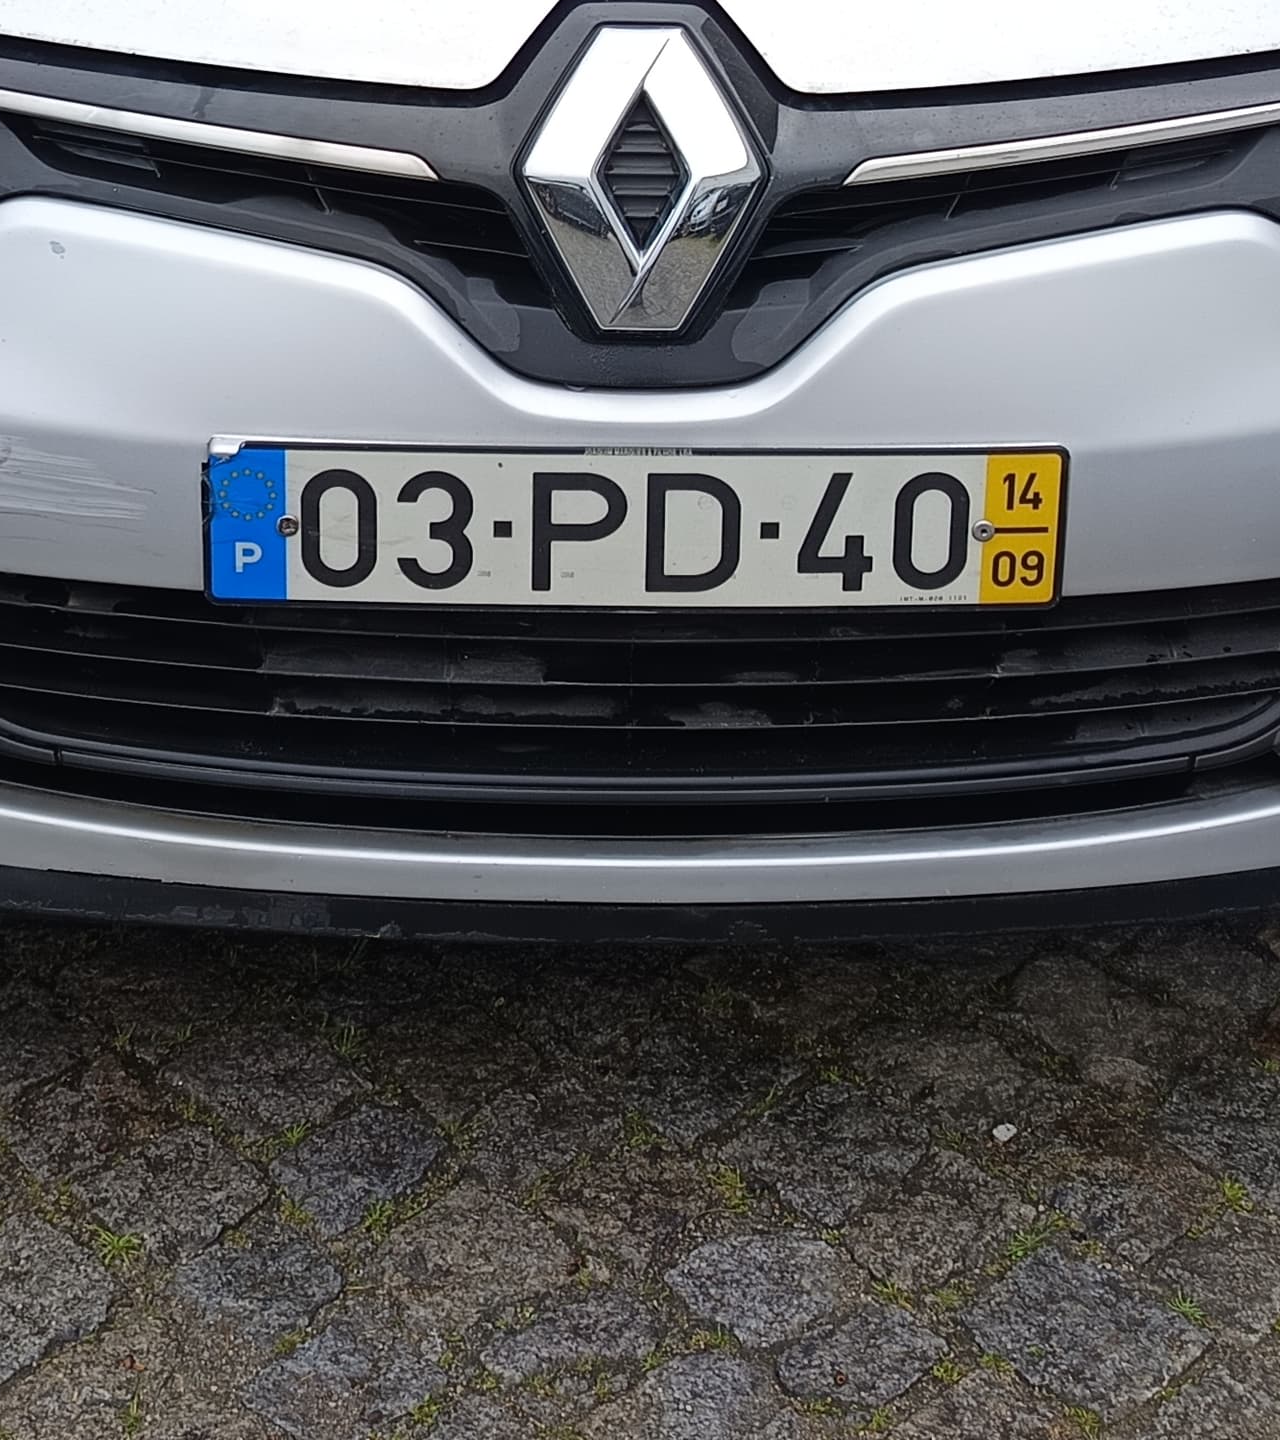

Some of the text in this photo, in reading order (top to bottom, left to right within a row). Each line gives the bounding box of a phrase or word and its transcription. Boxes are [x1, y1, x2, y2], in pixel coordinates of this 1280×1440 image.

[1002, 472, 1044, 511] 14
[234, 541, 263, 573] P
[991, 550, 1046, 588] 09
